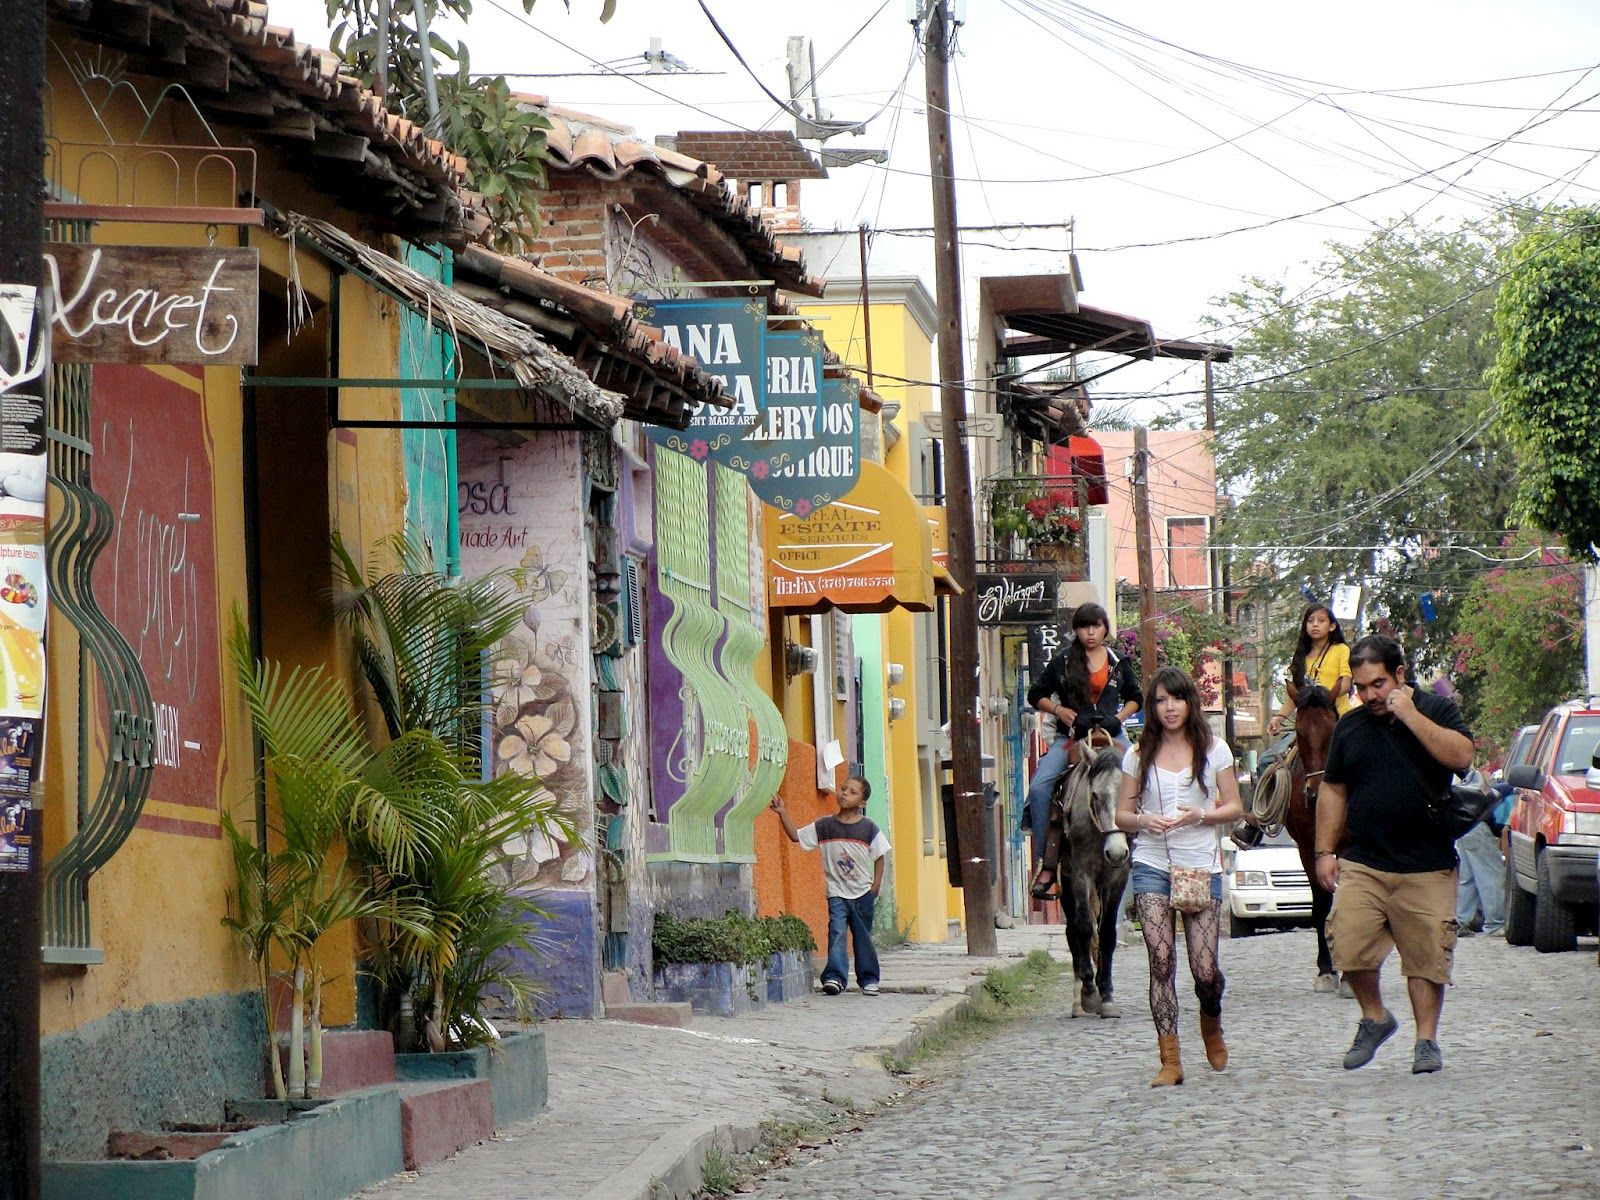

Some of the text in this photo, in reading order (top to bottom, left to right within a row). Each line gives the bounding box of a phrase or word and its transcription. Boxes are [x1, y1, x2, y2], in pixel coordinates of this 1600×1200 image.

[663, 323, 742, 365] ANA
[767, 356, 817, 394] RIA
[708, 417, 735, 426] MADE
[737, 416, 757, 425] ART
[807, 506, 855, 521] REAL
[779, 521, 881, 535] ESTATE
[494, 526, 528, 553] Art
[799, 533, 869, 544] SERVICES
[778, 549, 822, 562] OFFICE
[817, 575, 846, 593] (376)
